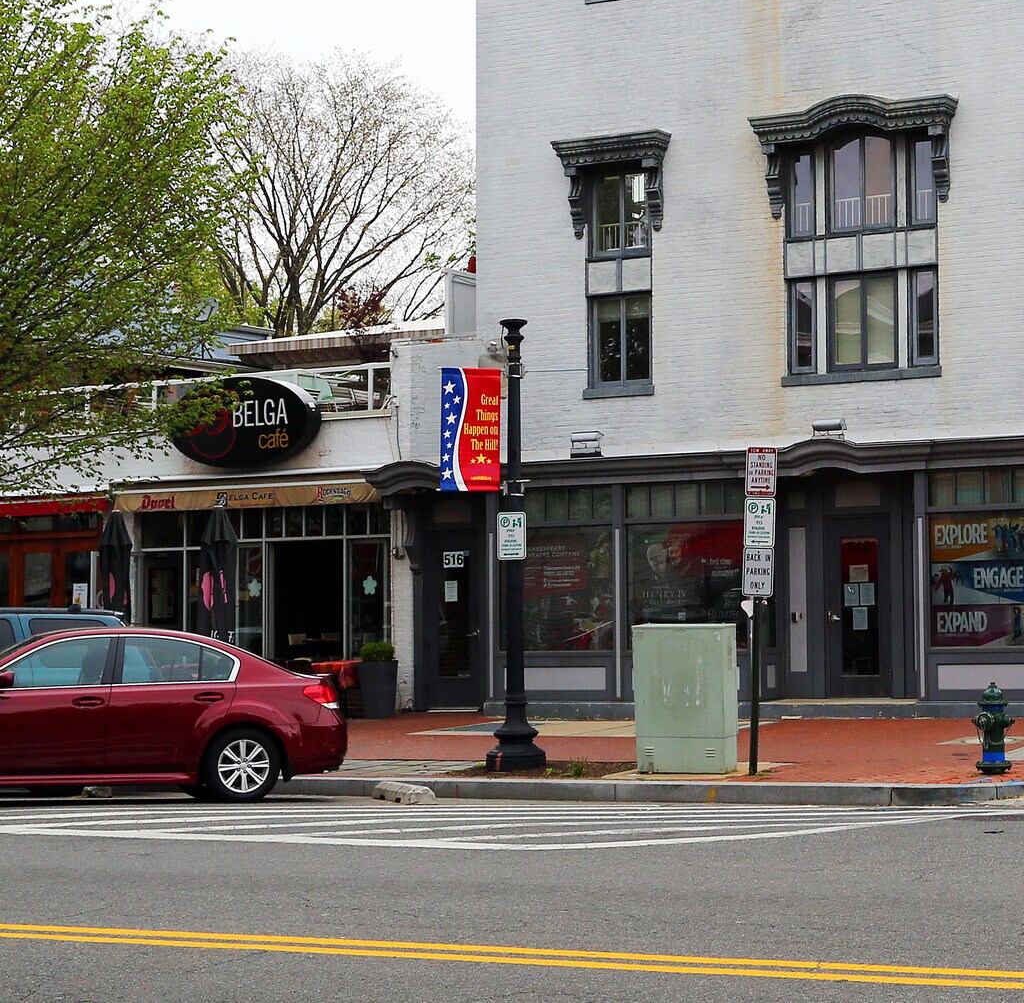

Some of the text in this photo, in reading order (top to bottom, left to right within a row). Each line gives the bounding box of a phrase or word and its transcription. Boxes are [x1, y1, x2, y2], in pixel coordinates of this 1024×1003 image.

[481, 394, 499, 406] Great
[232, 398, 289, 428] BELGA
[476, 409, 499, 423] Things
[464, 423, 499, 436] Happen on
[258, 428, 289, 449] café
[471, 439, 499, 451] The Hill!
[934, 523, 988, 546] EXPLORE
[443, 554, 464, 566] 516
[746, 554, 761, 562] BACK
[746, 568, 770, 576] PARKING
[974, 566, 1024, 589] ENGAGE
[750, 582, 765, 590] ONLY
[936, 611, 988, 633] EXPAND
